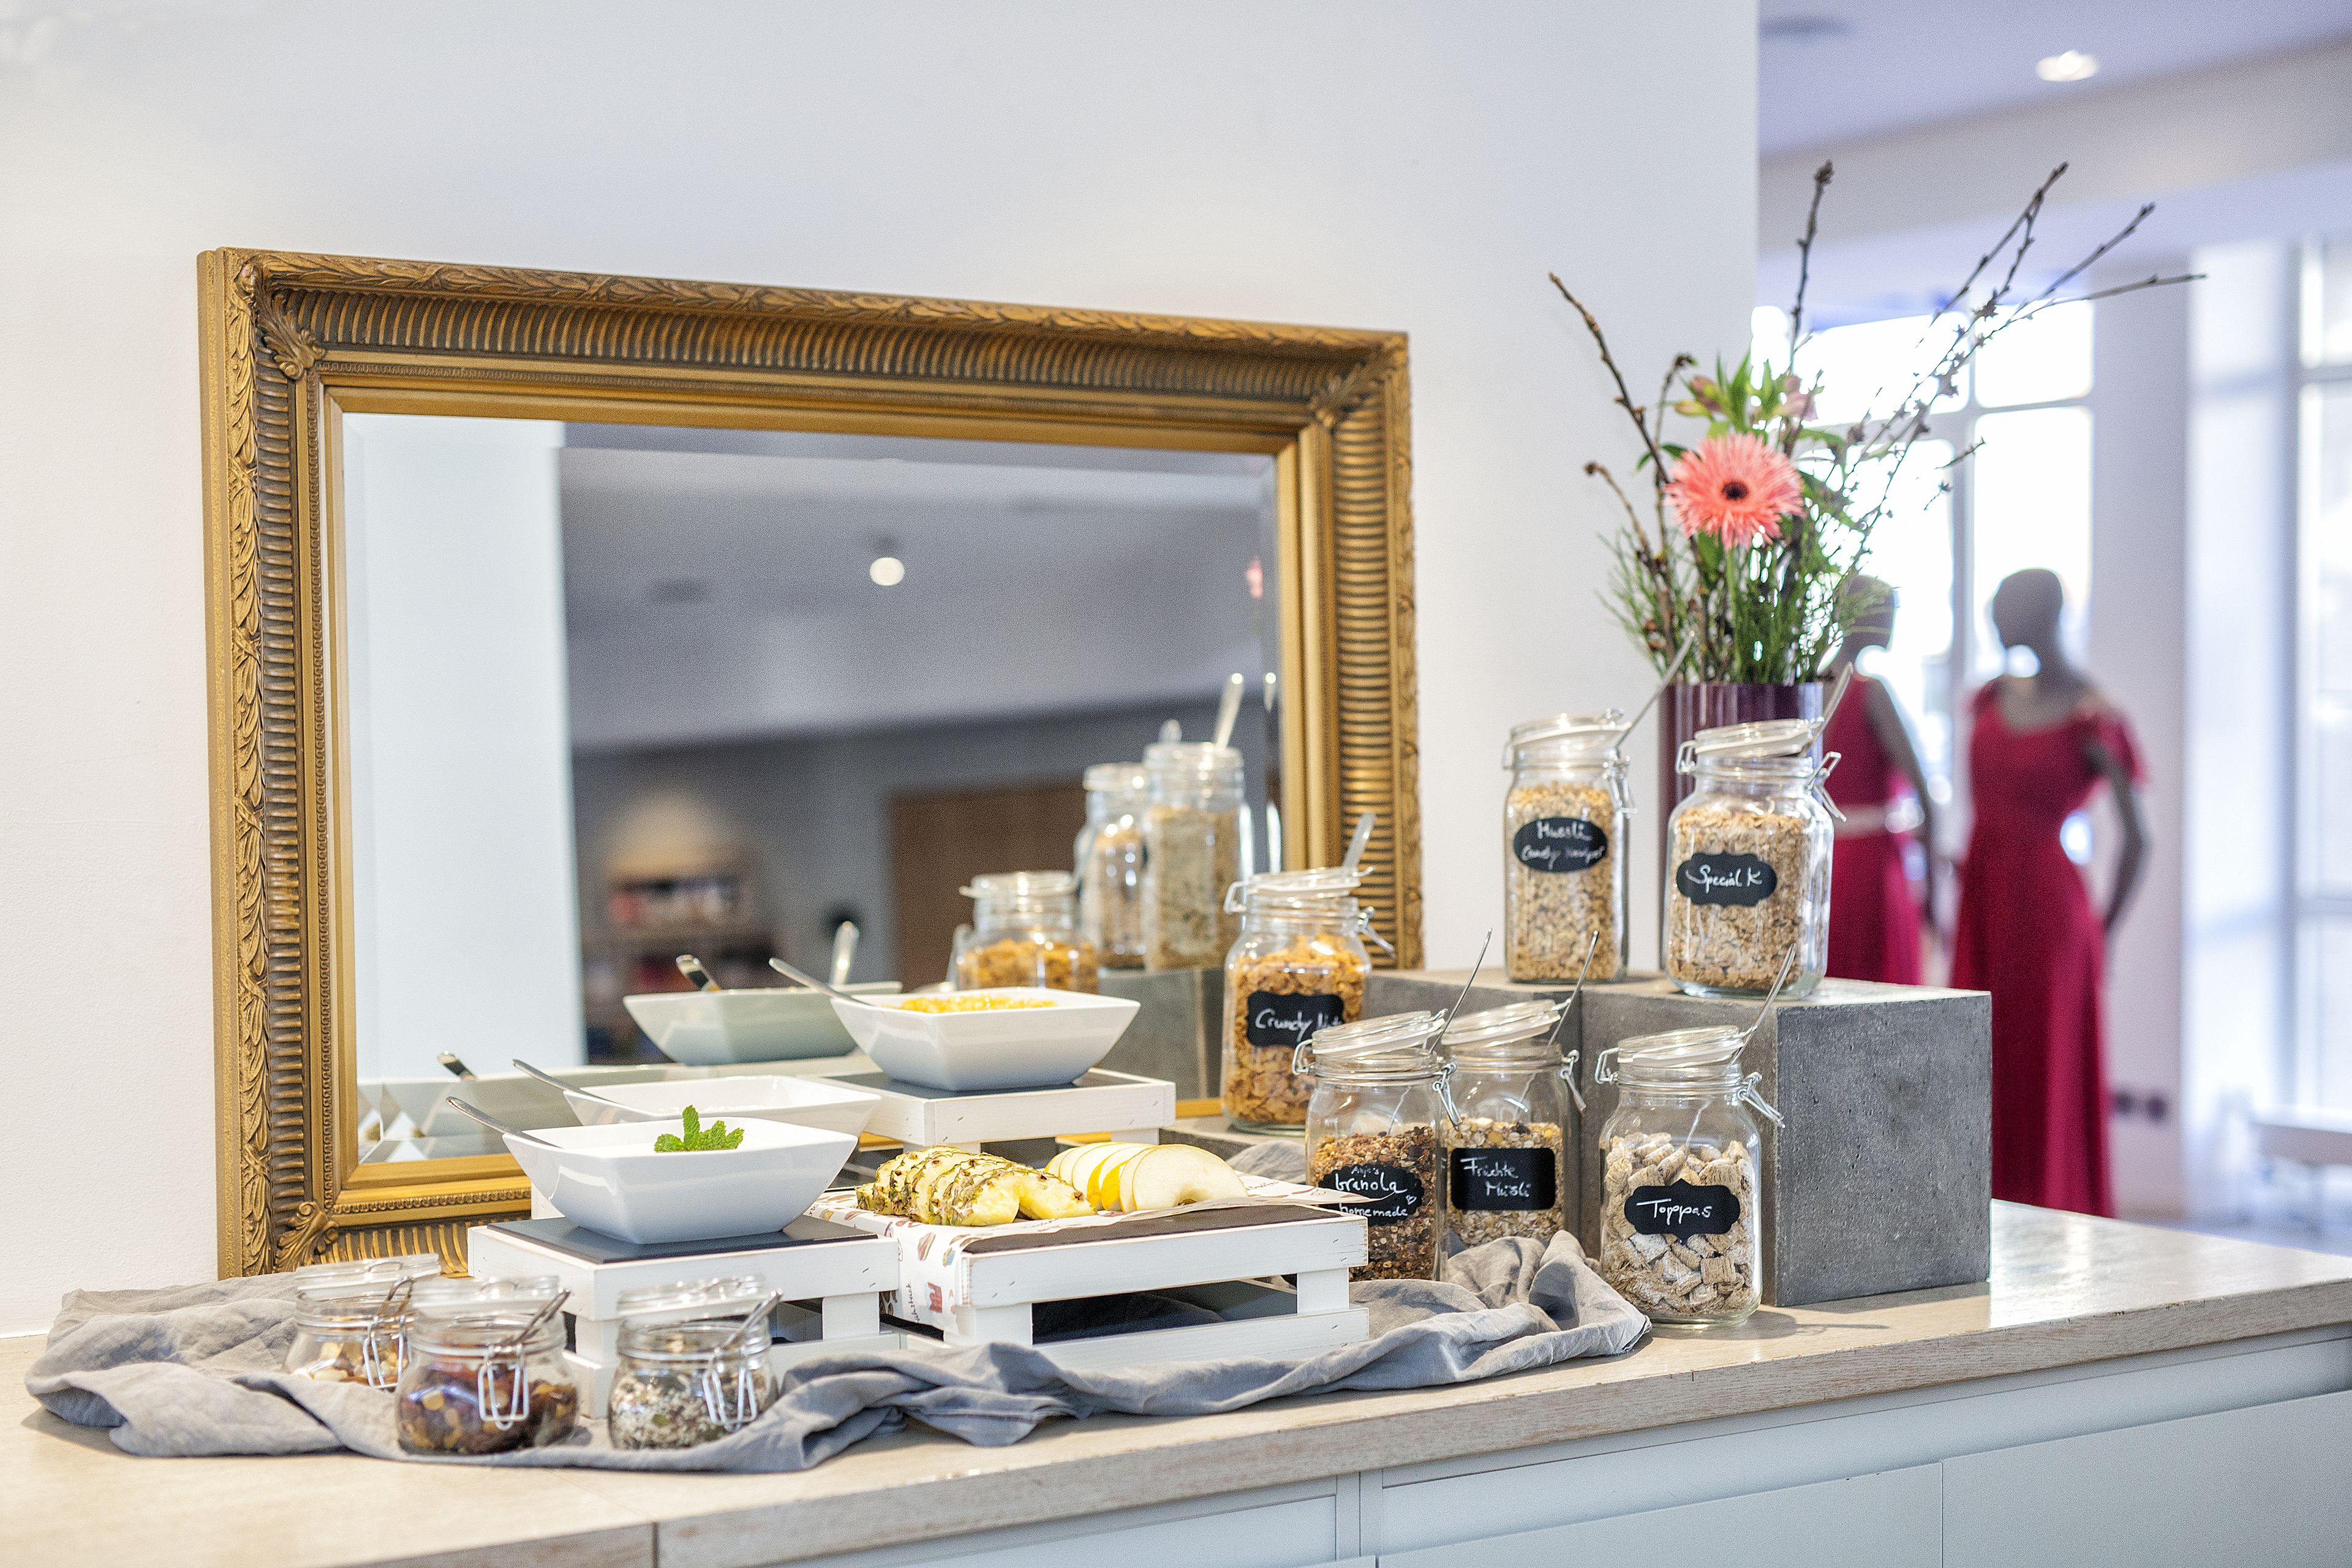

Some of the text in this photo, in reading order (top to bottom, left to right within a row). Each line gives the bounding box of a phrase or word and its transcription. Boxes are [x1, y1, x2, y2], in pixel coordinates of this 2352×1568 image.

[1685, 864, 1763, 894] Special K
[1338, 1202, 1409, 1218] homemade
[1636, 1198, 1713, 1226] Toppas
